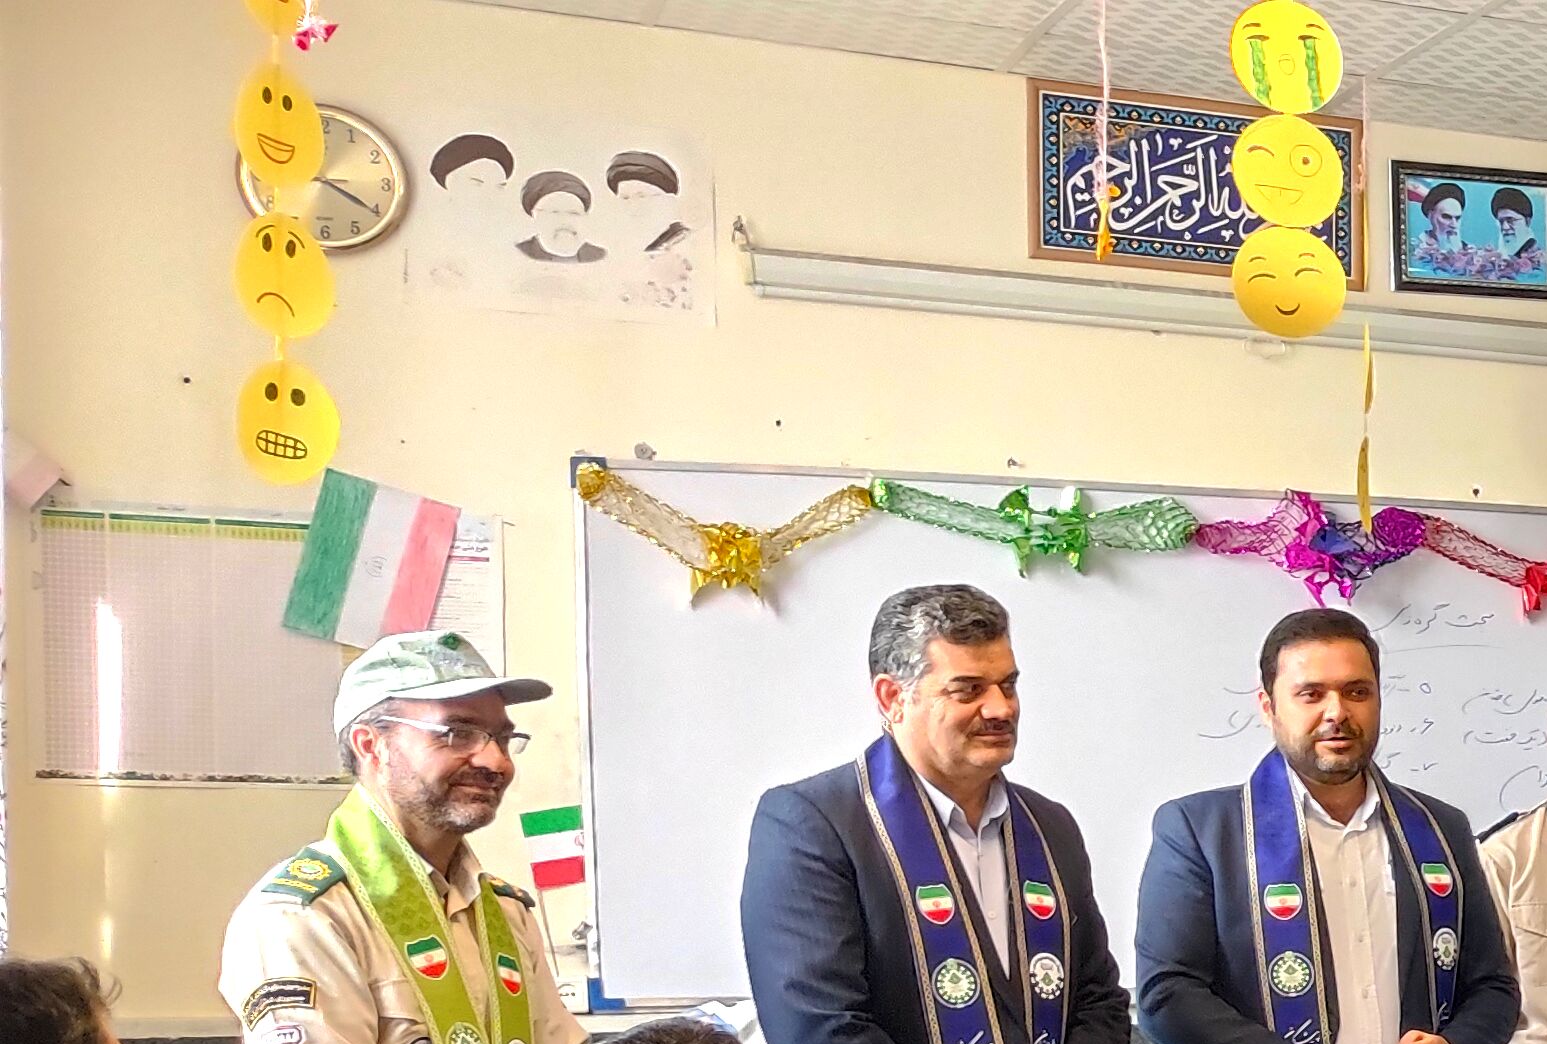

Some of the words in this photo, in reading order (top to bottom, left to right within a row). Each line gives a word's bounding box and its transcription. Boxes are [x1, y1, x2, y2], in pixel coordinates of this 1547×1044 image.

[347, 129, 356, 143] 1
[370, 150, 380, 164] 2
[381, 178, 391, 192] 3
[320, 225, 331, 240] 6
[351, 221, 360, 235] 5
